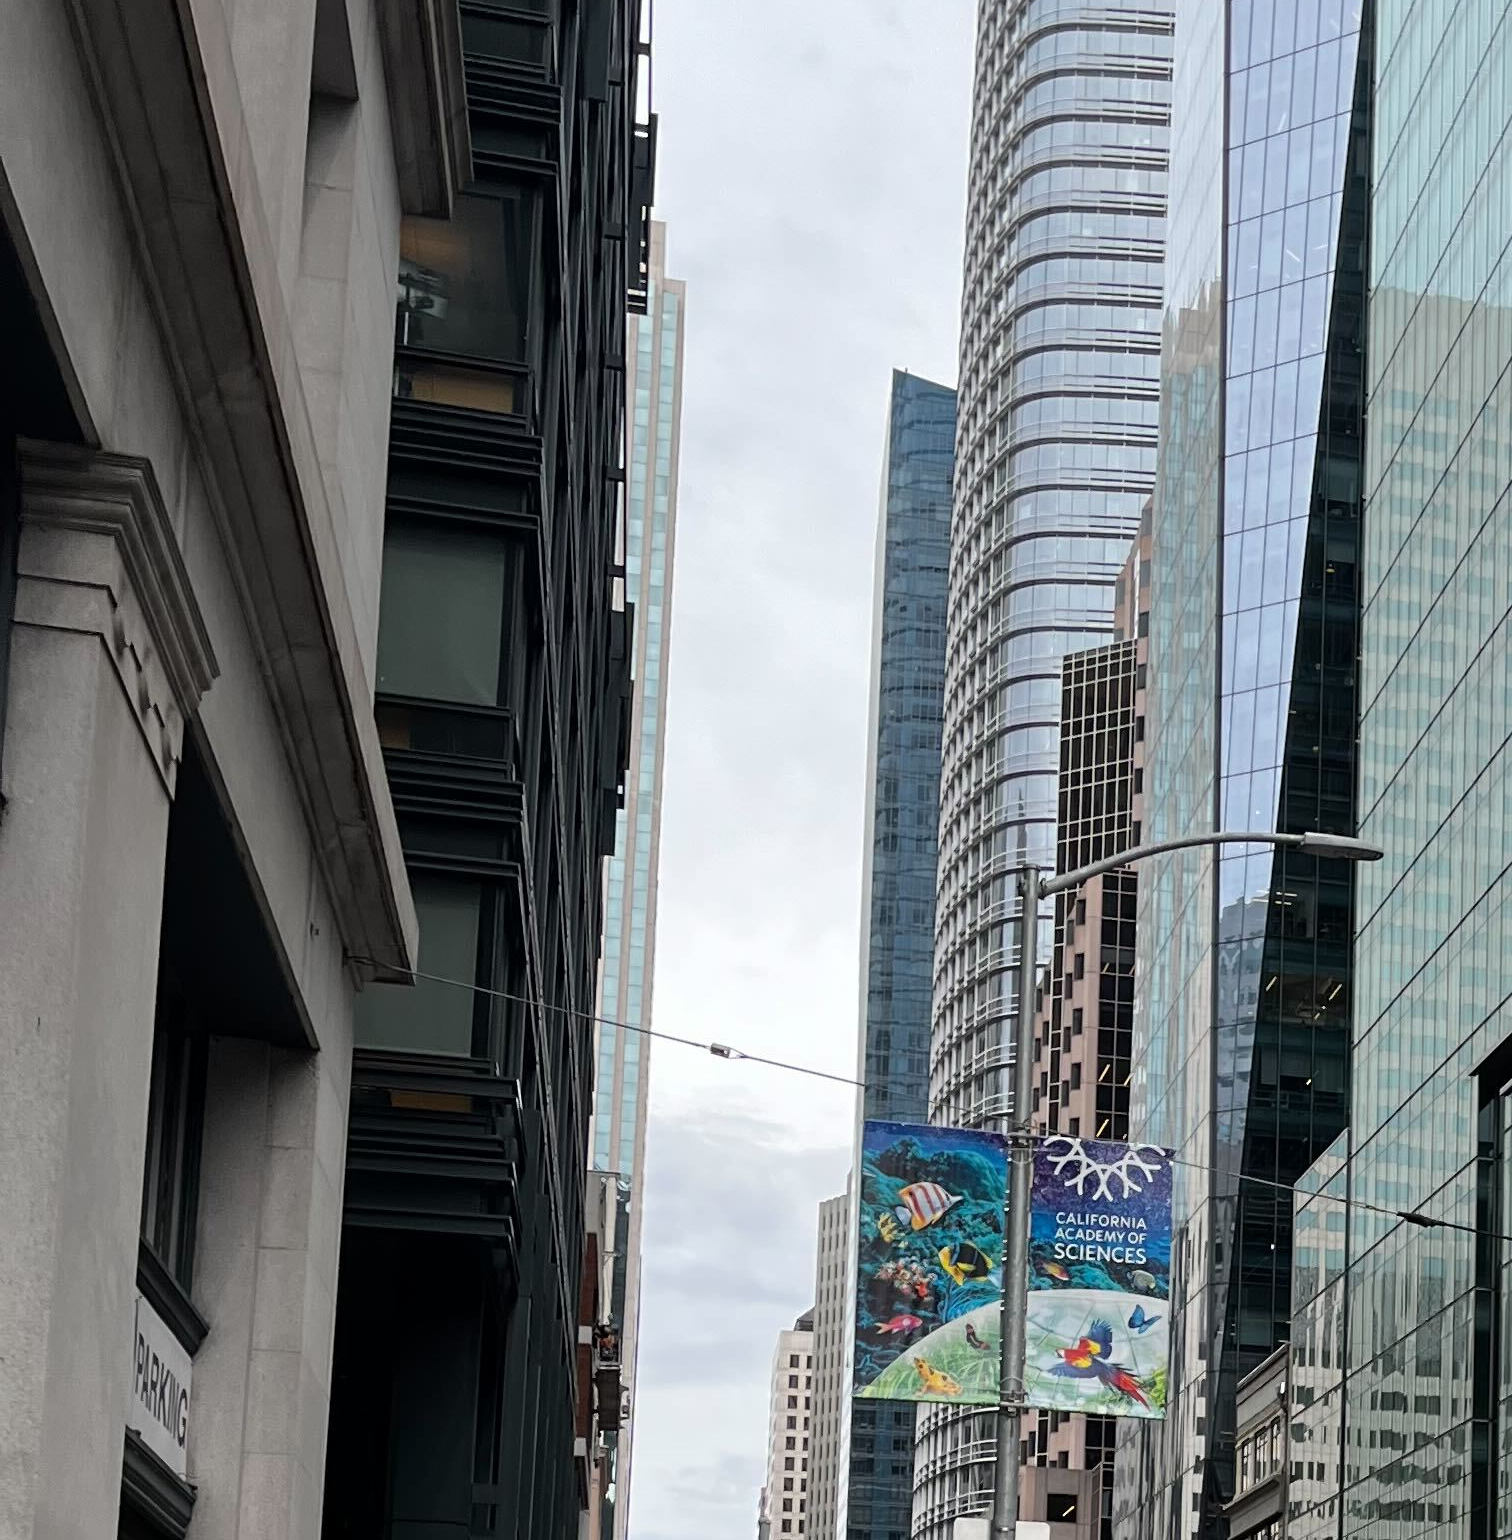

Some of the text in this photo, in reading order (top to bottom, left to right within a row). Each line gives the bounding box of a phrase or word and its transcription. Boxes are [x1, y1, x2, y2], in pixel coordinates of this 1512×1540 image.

[1056, 1212, 1147, 1230] CALIFORNIA
[1055, 1228, 1147, 1244] ACADEMY OF
[1054, 1243, 1147, 1265] SCIENCES
[135, 1332, 188, 1448] PARKING
